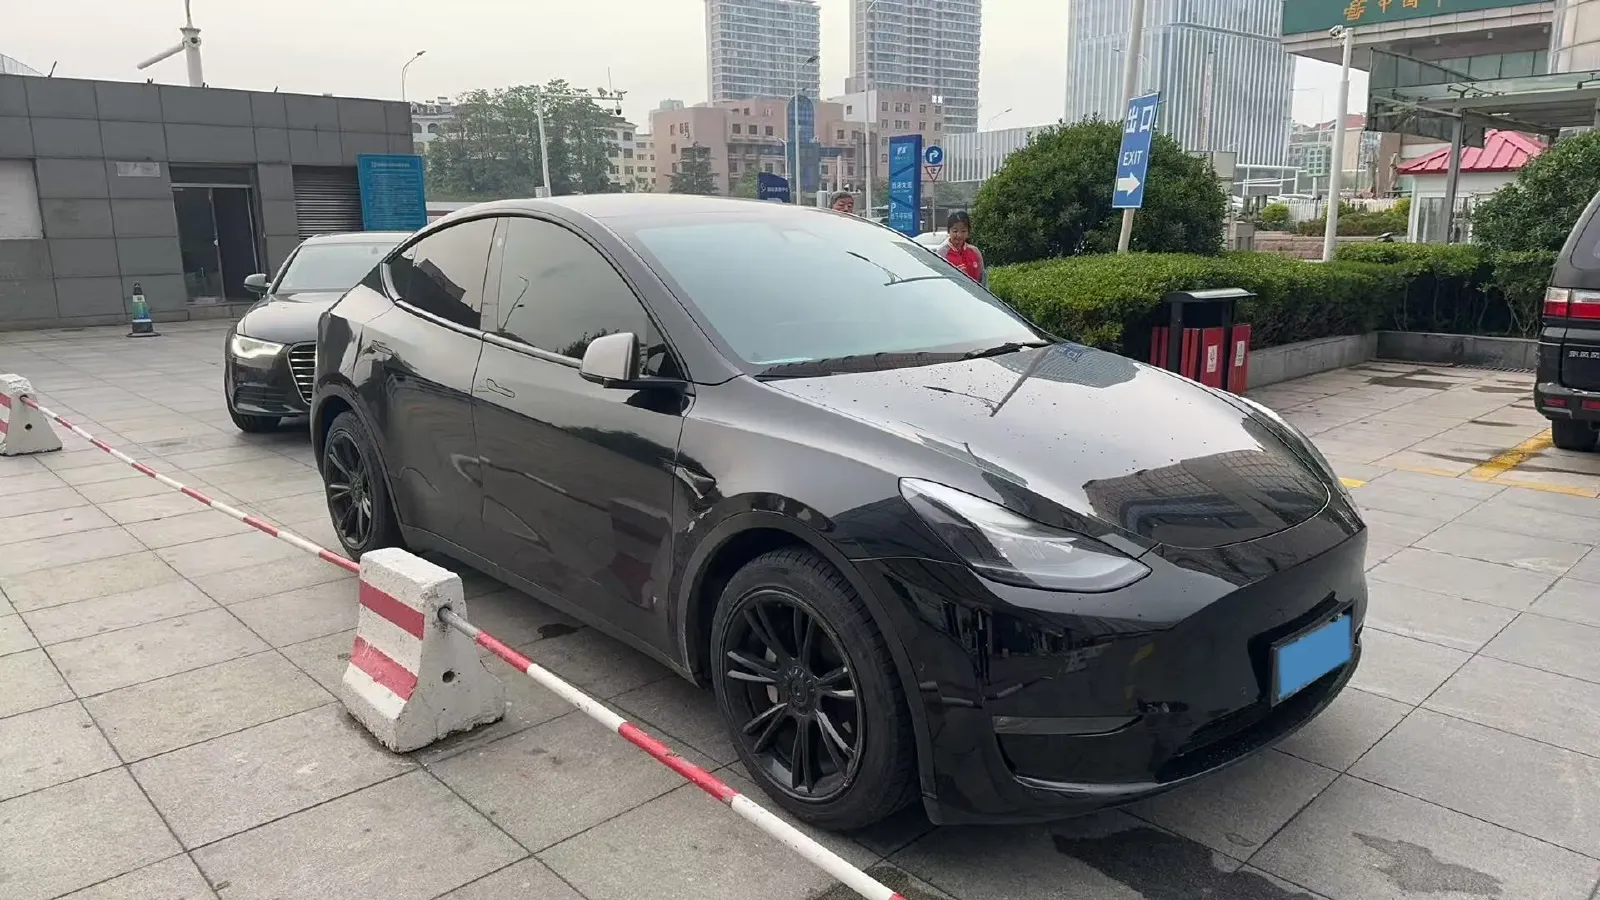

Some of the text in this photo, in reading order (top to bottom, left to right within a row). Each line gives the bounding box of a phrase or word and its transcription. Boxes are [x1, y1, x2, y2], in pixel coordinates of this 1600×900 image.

[1126, 105, 1153, 133] 出口
[1123, 151, 1143, 166] EXIT
[890, 202, 897, 212] P
